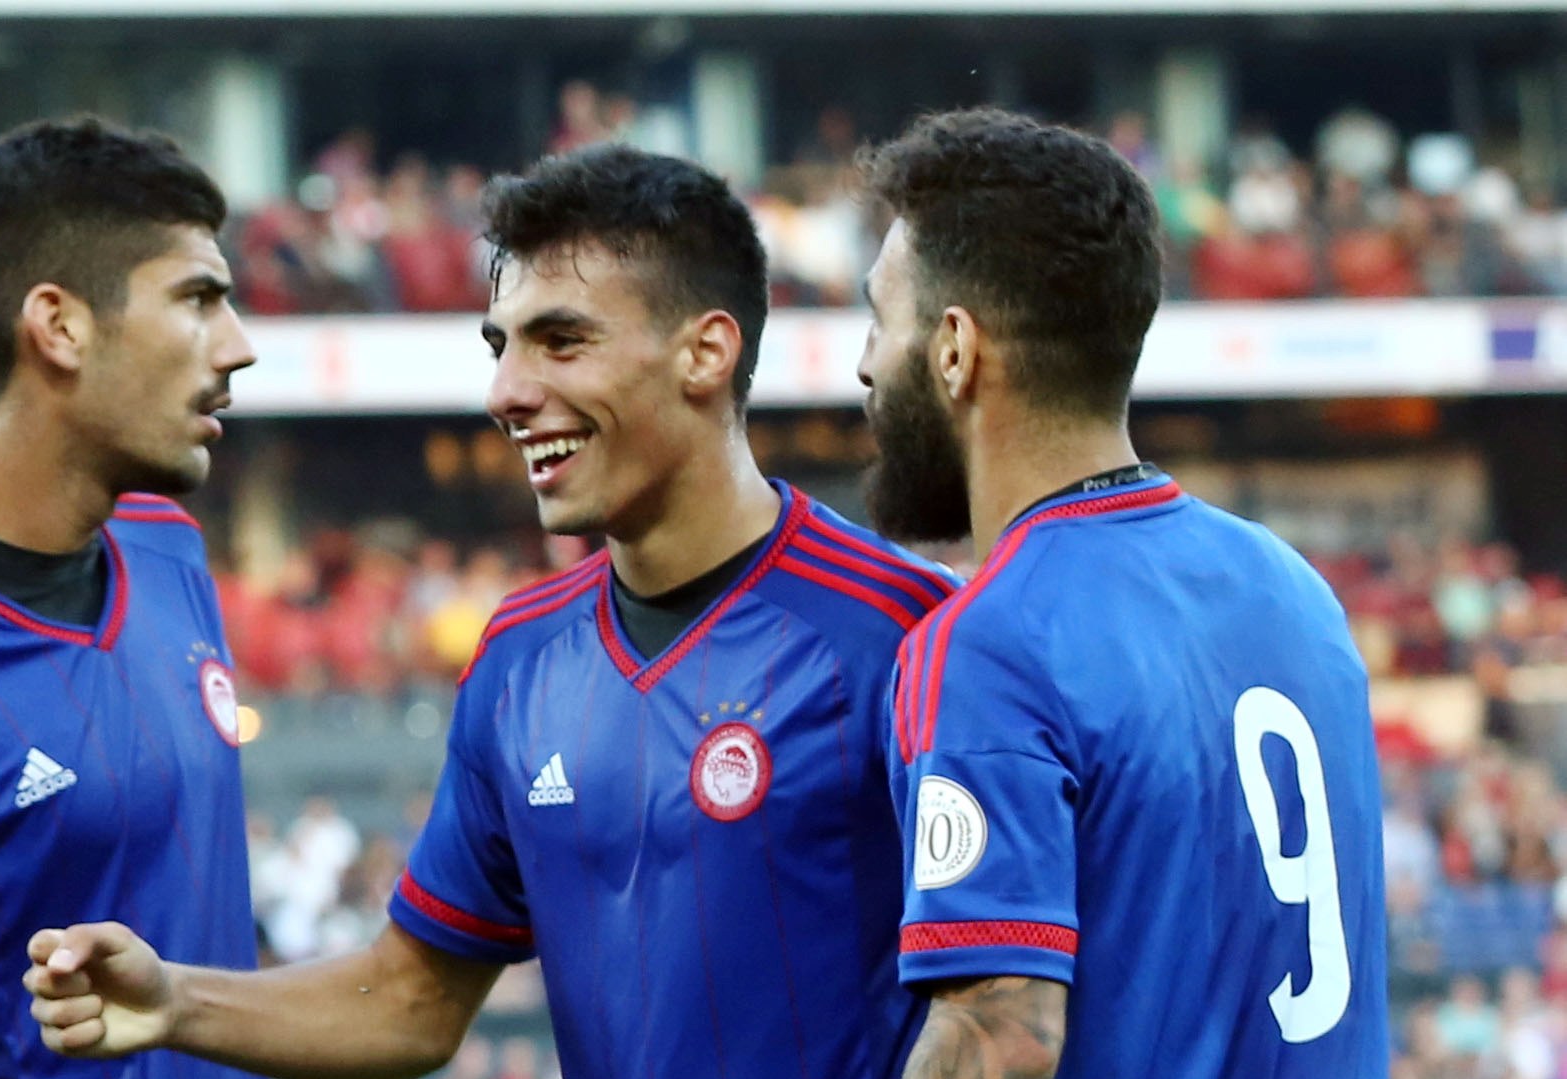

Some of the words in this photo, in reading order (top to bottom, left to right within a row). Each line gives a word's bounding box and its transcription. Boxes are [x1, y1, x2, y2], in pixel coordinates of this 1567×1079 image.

[14, 768, 78, 809] adidas
[527, 784, 575, 806] adidas
[1233, 686, 1352, 1043] 9
